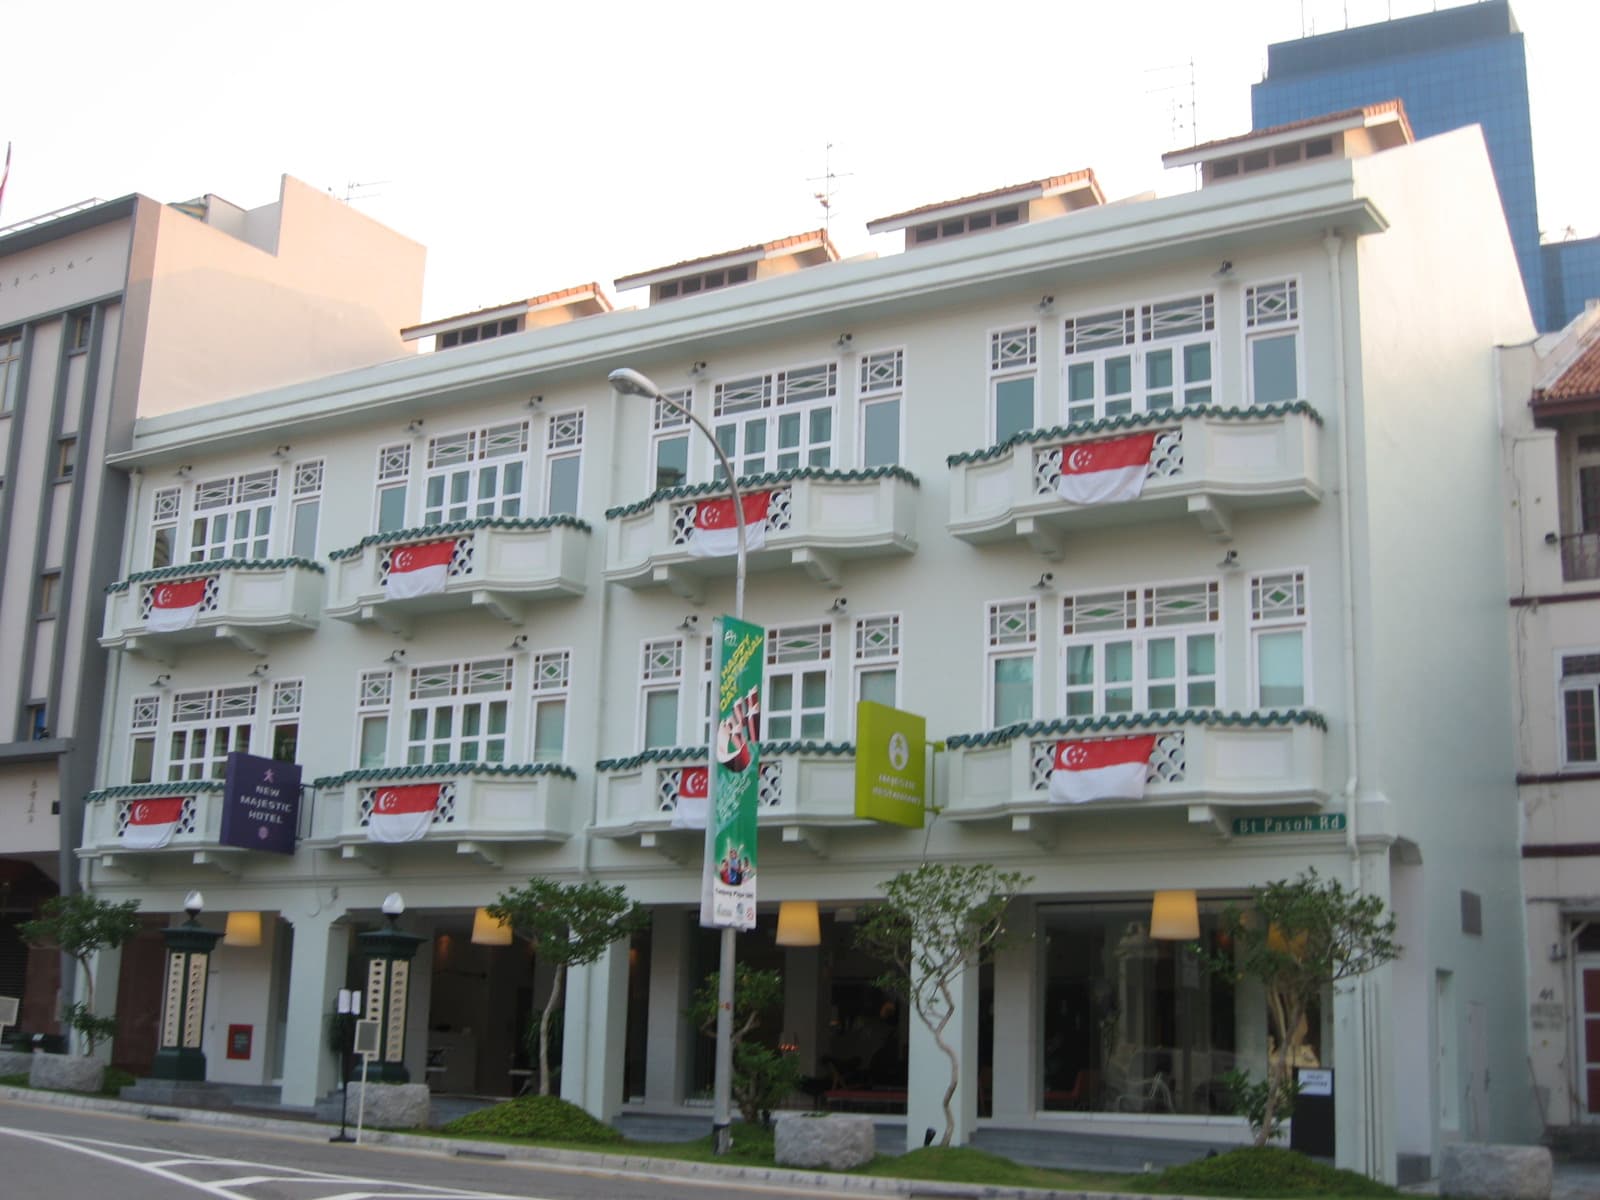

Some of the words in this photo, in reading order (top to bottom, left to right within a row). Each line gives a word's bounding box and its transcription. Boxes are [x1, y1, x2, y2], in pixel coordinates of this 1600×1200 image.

[256, 785, 280, 797] NEW
[240, 795, 292, 813] MAJESTIC
[248, 810, 283, 825] HOTEL
[1239, 819, 1257, 834] Bt
[1263, 816, 1313, 833] Pasoh
[1319, 815, 1340, 831] Rd
